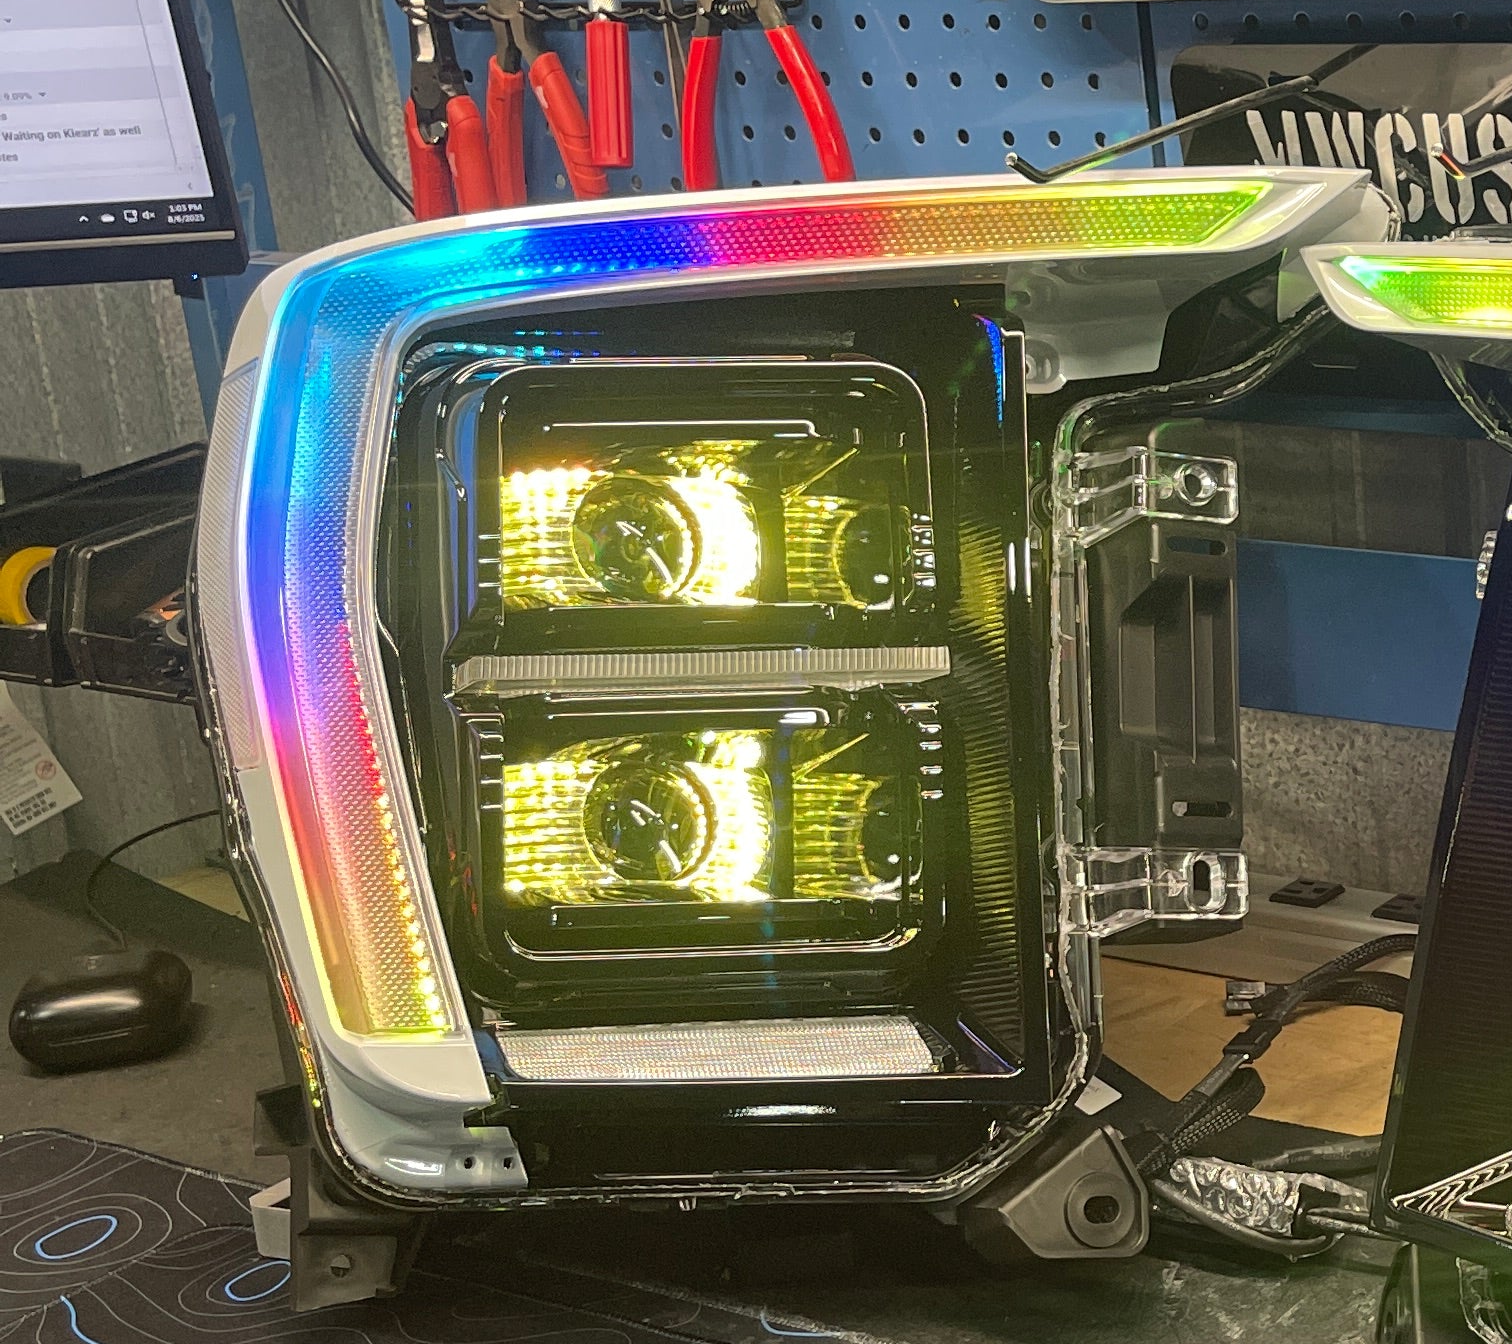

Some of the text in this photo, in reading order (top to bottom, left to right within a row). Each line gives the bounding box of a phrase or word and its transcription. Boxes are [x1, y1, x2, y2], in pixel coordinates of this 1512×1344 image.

[2, 130, 45, 142] Waiting
[47, 130, 61, 139] on
[103, 128, 117, 136] as
[119, 125, 141, 135] well
